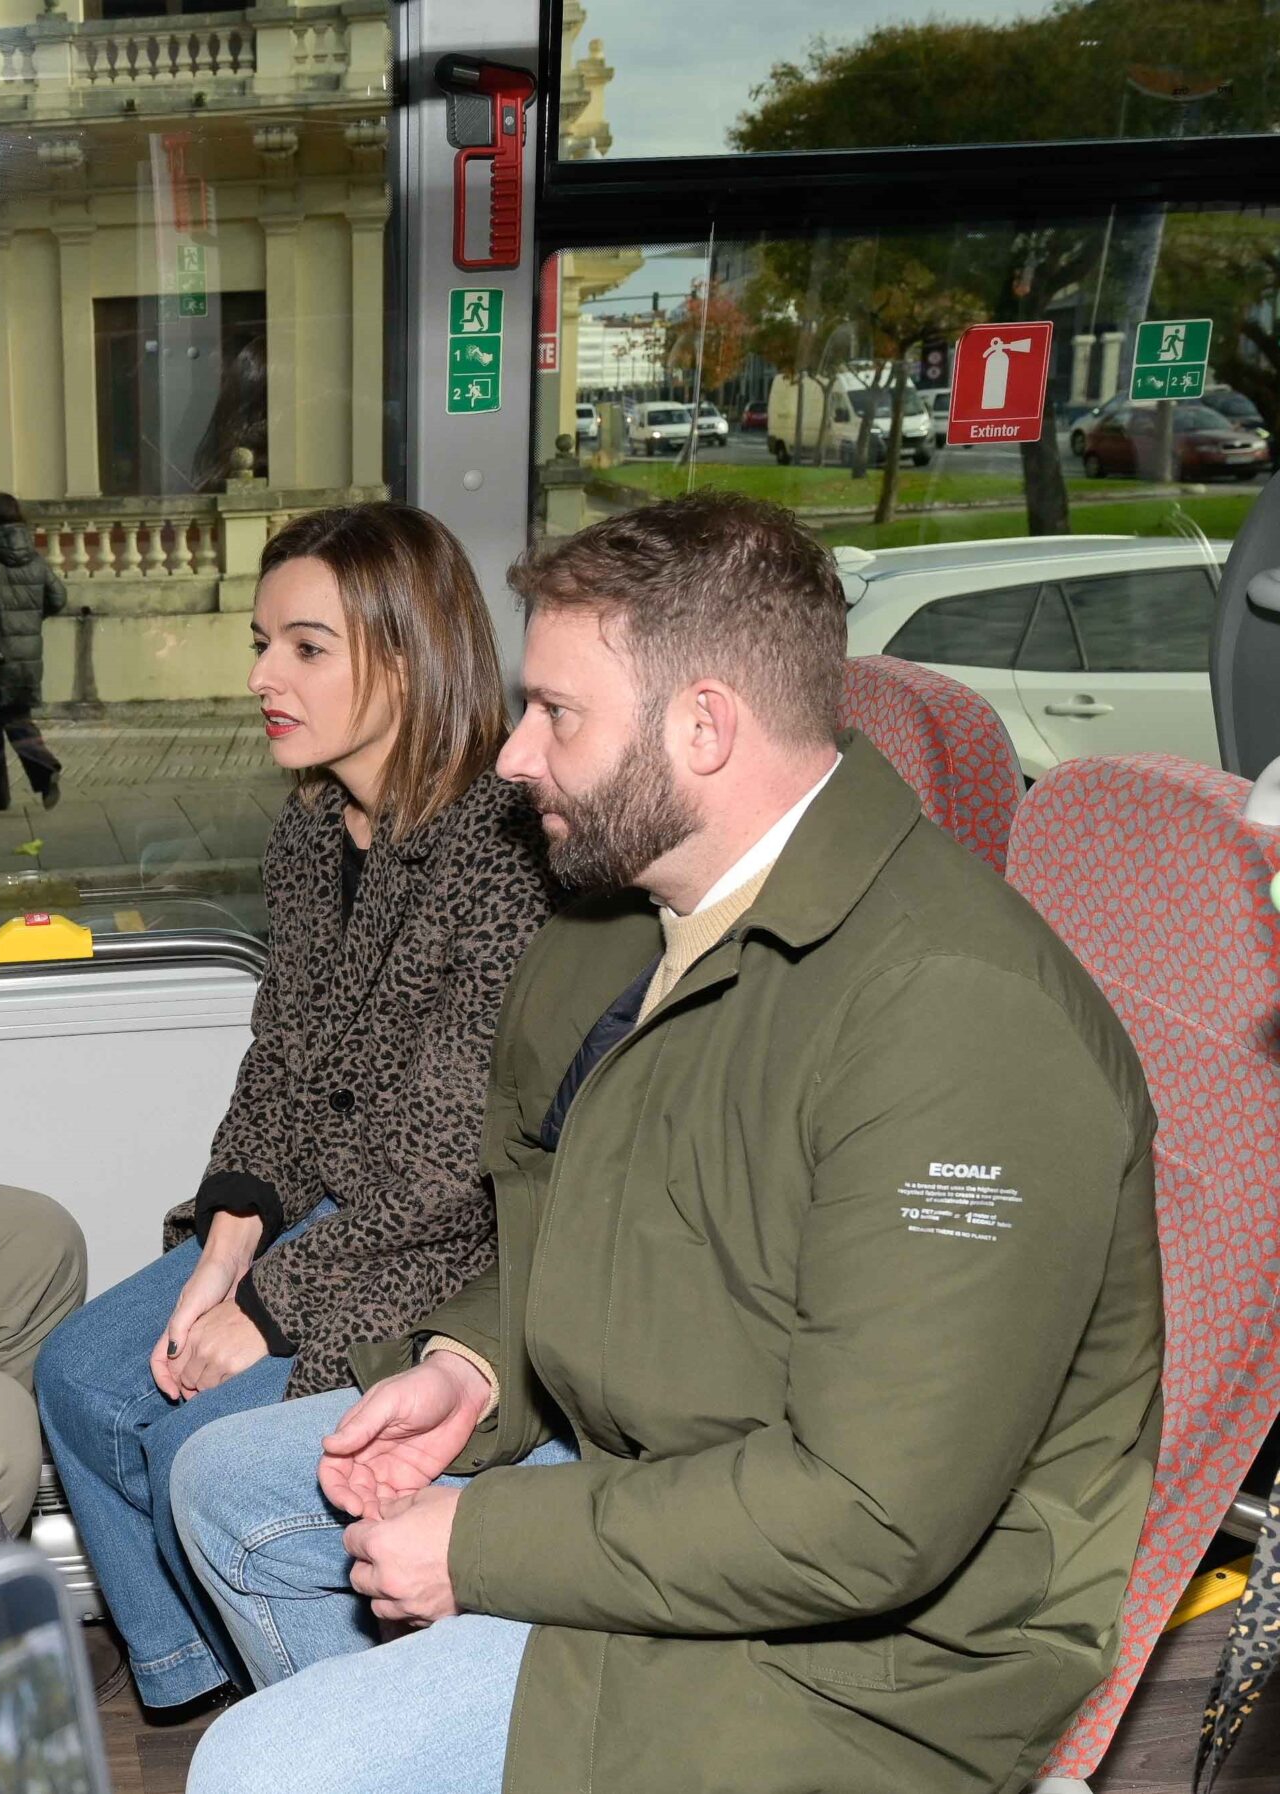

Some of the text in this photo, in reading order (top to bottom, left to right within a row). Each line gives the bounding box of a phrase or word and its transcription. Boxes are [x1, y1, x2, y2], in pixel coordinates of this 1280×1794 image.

[454, 350, 461, 361] 1
[453, 388, 461, 400] 2
[970, 423, 1020, 438] Extintor
[928, 1162, 1002, 1180] ECOALF
[900, 1207, 920, 1219] 70
